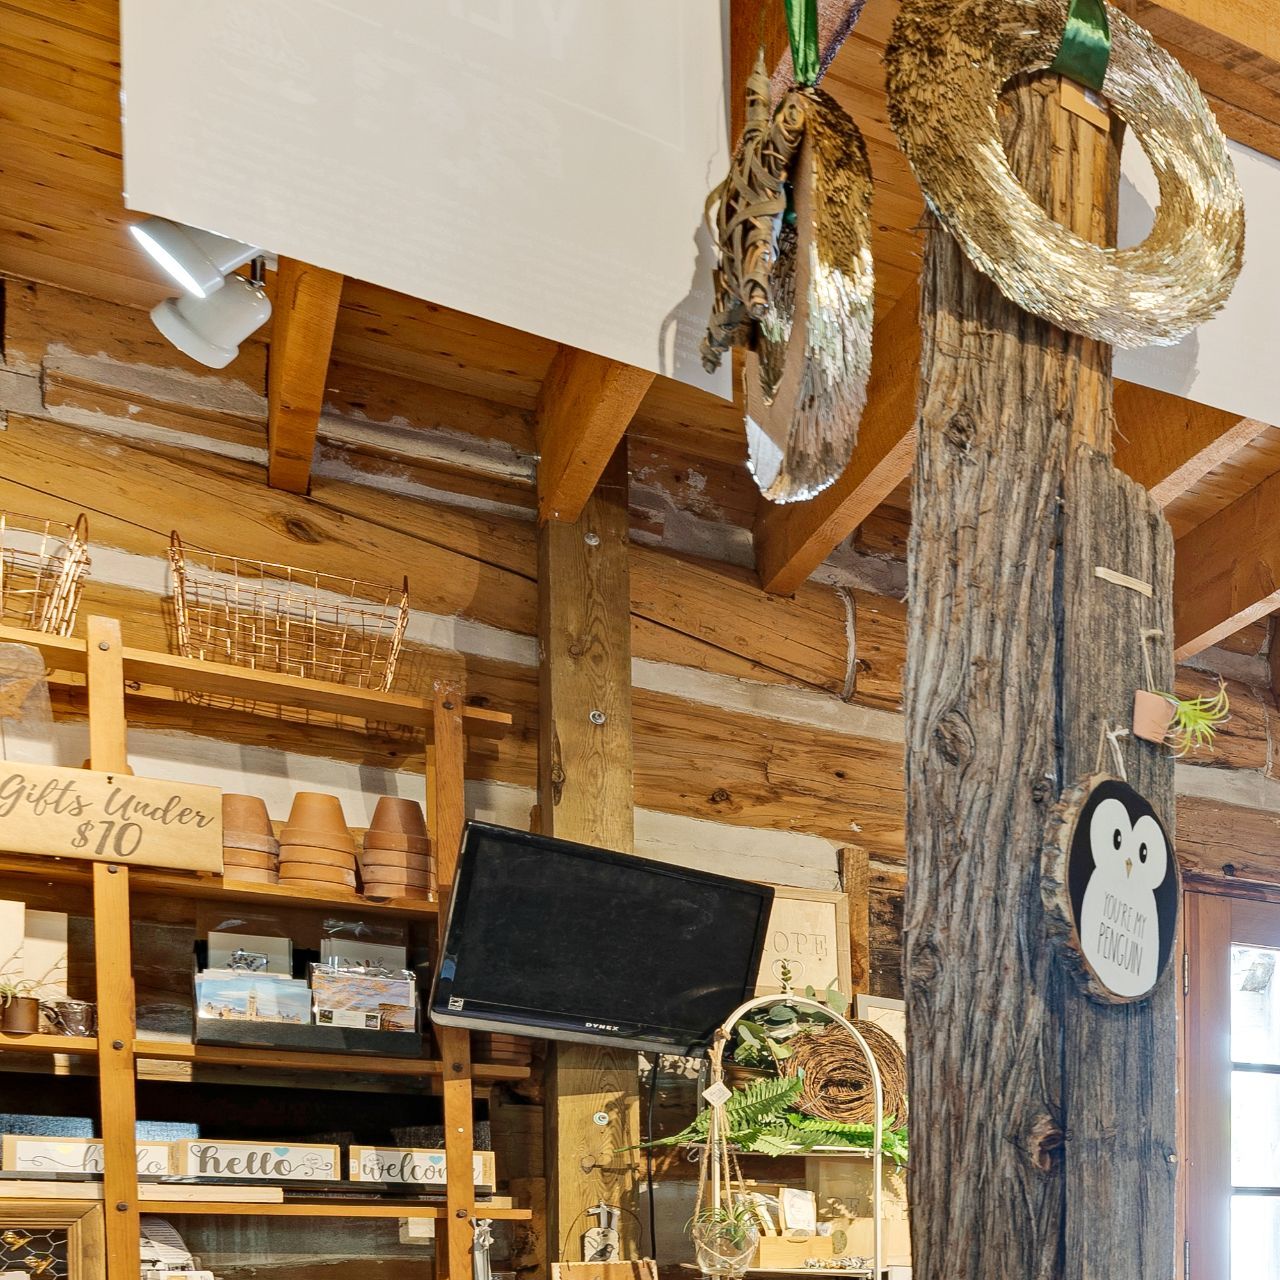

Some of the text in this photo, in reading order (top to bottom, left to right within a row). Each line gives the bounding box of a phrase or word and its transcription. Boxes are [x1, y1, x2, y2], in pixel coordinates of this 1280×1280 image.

[0, 774, 215, 829] Gifts Under
[71, 820, 143, 857] $10
[1133, 912, 1147, 939] MY
[763, 930, 828, 957] OPE
[1097, 922, 1143, 976] PENGUIN
[585, 1021, 619, 1032] DYNEX
[190, 1144, 292, 1177] hello
